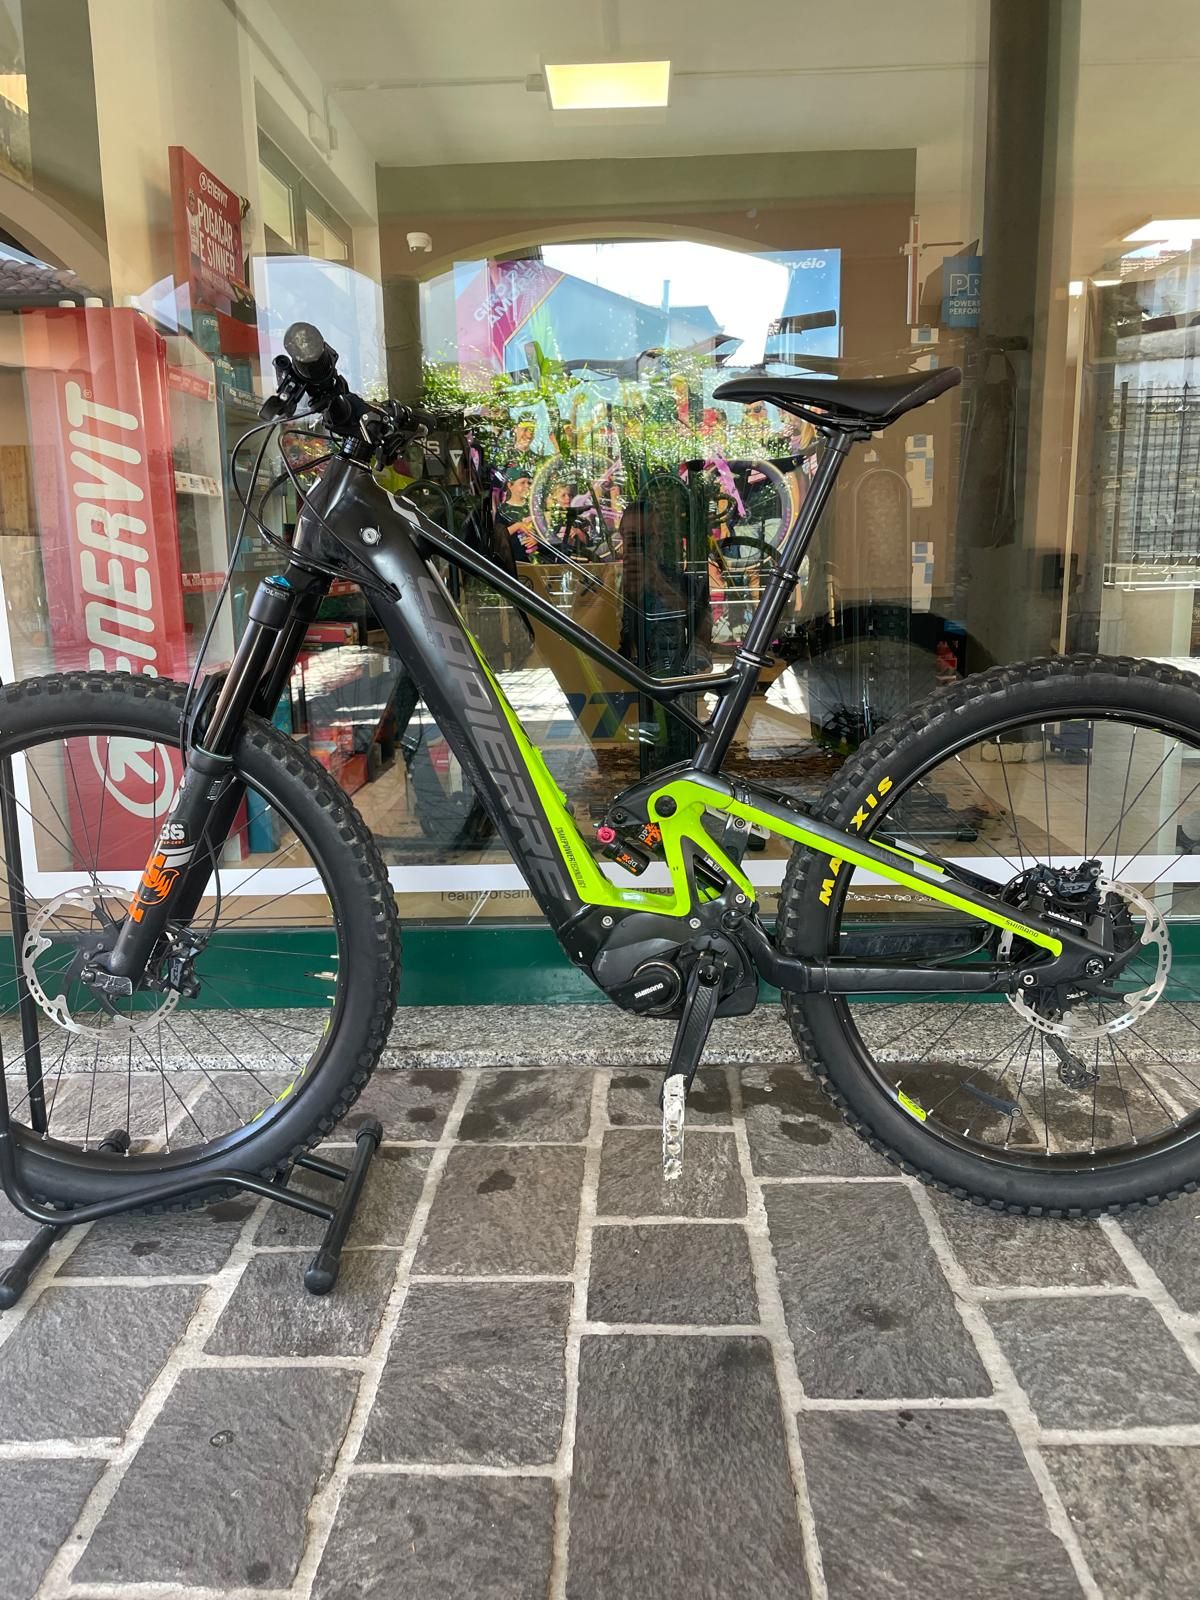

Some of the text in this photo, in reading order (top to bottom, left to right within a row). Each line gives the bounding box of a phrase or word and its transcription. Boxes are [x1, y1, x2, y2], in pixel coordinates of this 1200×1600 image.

[207, 178, 228, 208] ENERVIT
[197, 197, 234, 252] POGAČAR
[199, 231, 235, 276] E SINNER
[819, 776, 893, 906] MAXIS
[1005, 919, 1039, 939] SHIMANO
[634, 982, 664, 999] SHIMANO
